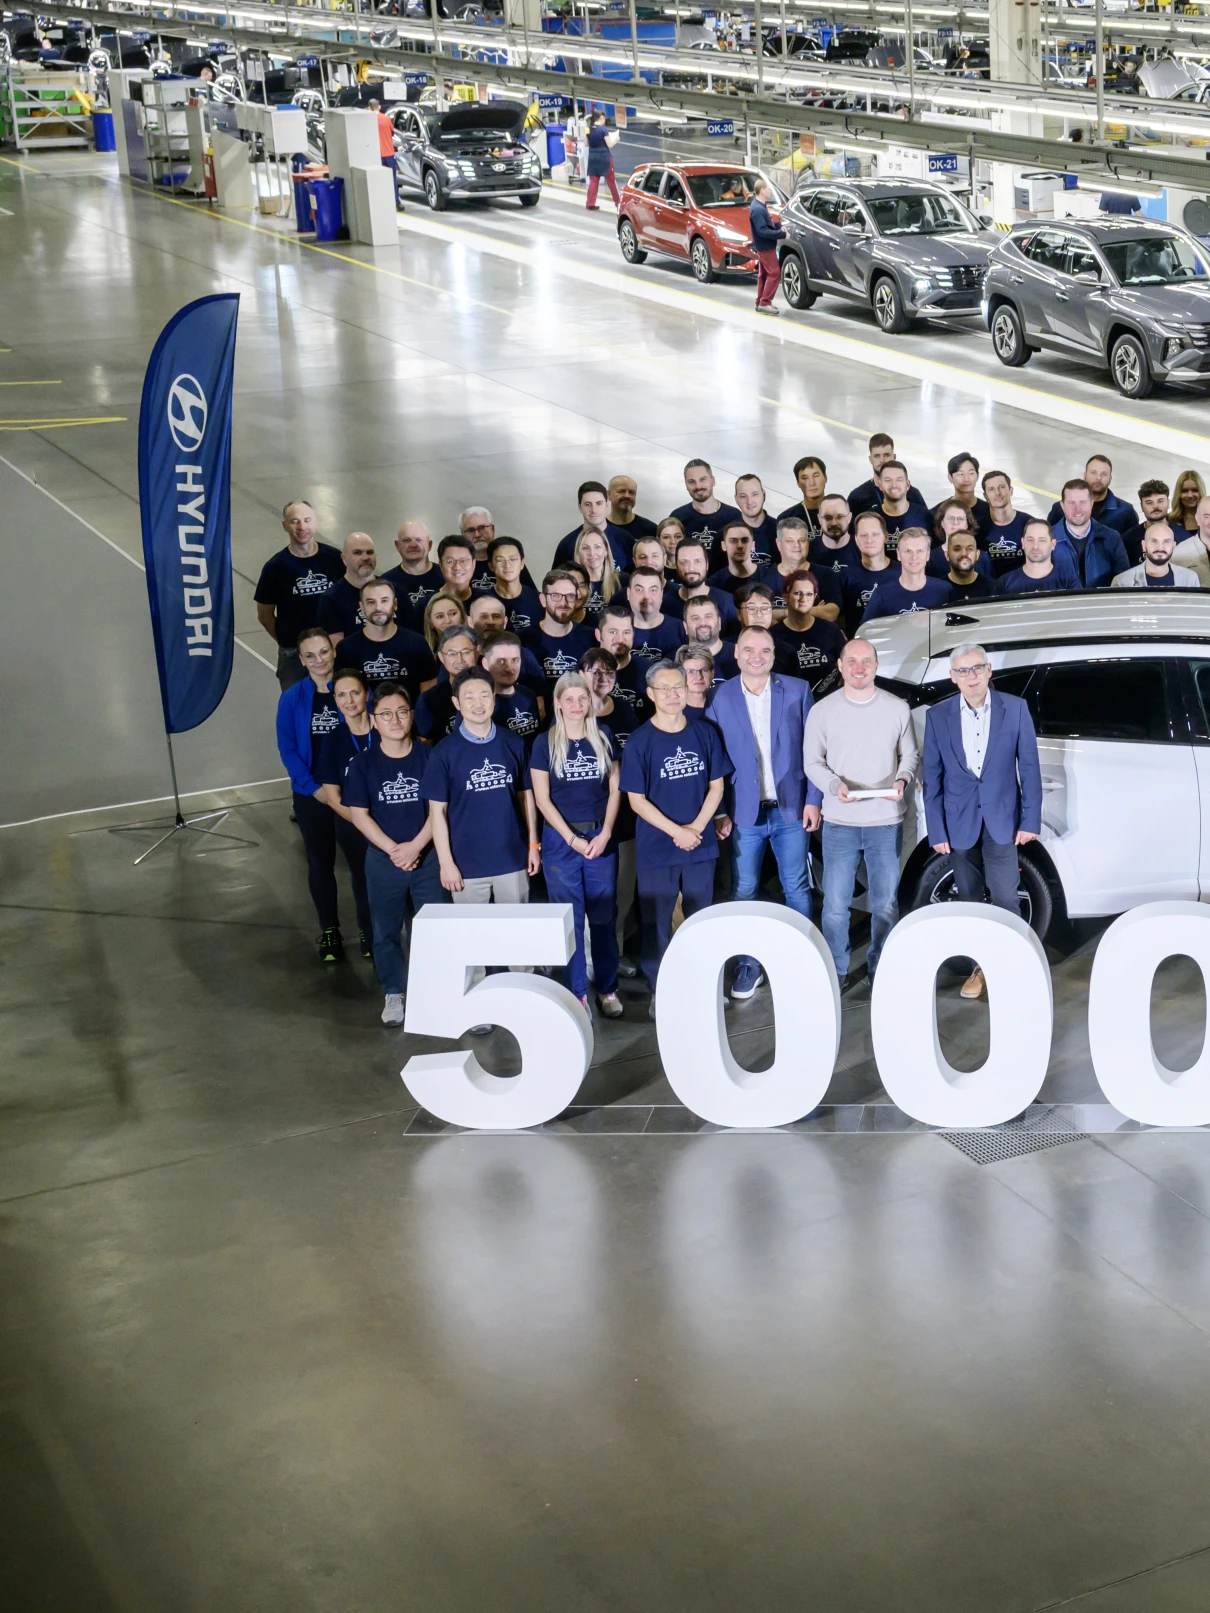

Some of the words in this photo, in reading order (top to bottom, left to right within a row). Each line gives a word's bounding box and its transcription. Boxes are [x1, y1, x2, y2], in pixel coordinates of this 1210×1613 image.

[539, 98, 562, 106] OK-19
[708, 124, 733, 134] OK-20
[929, 158, 957, 170] OK-21
[175, 464, 213, 657] HYUNDAI
[400, 903, 594, 1130] 5
